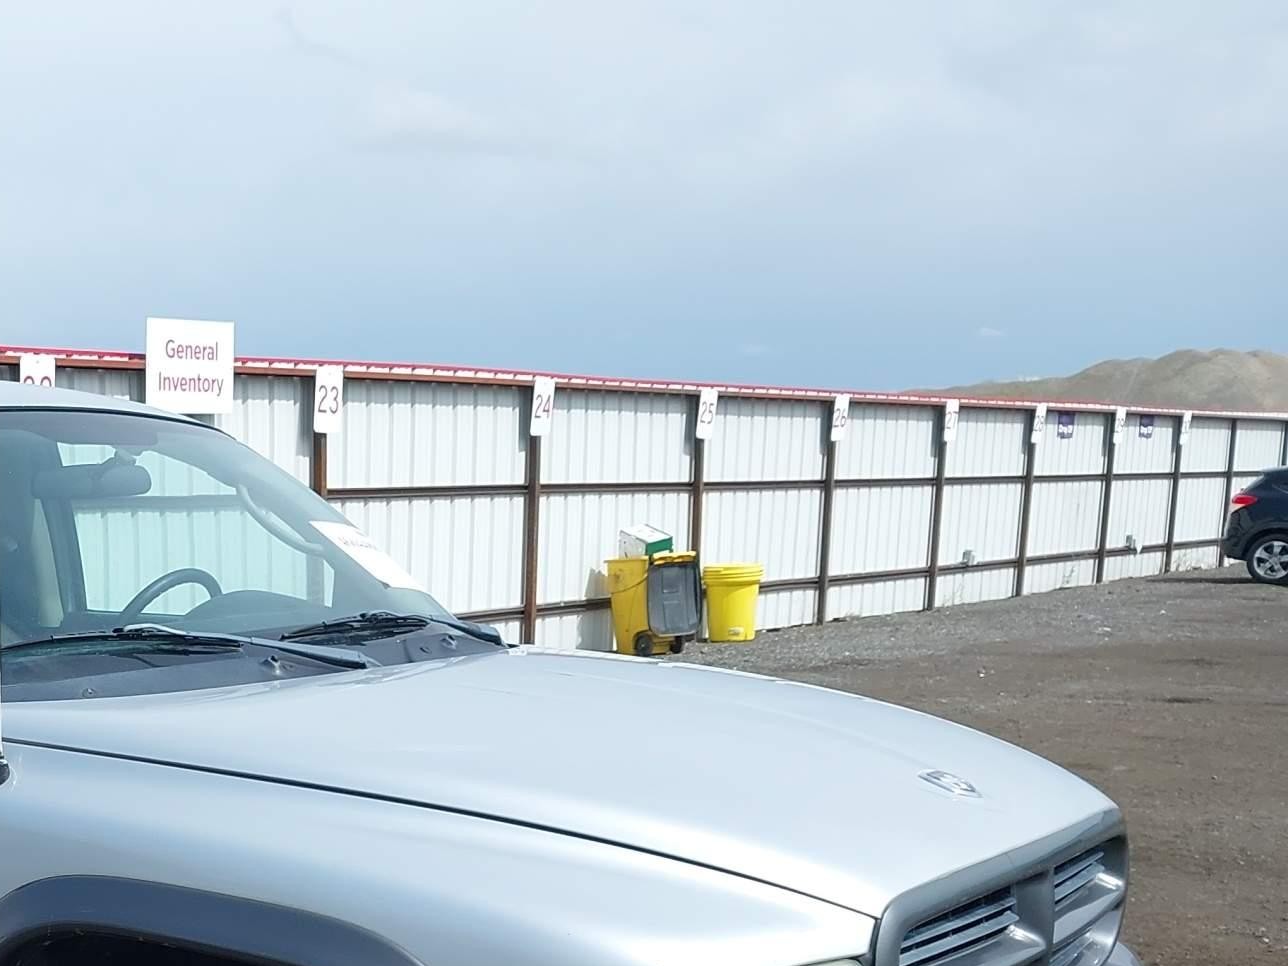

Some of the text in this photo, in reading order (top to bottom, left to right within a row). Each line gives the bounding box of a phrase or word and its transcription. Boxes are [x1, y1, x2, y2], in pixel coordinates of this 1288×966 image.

[165, 339, 218, 362] General
[158, 372, 224, 397] Inventory
[318, 385, 339, 415] 23
[534, 394, 551, 419] 24
[699, 401, 715, 425] 25
[833, 408, 847, 428] 26
[945, 411, 959, 430] 27
